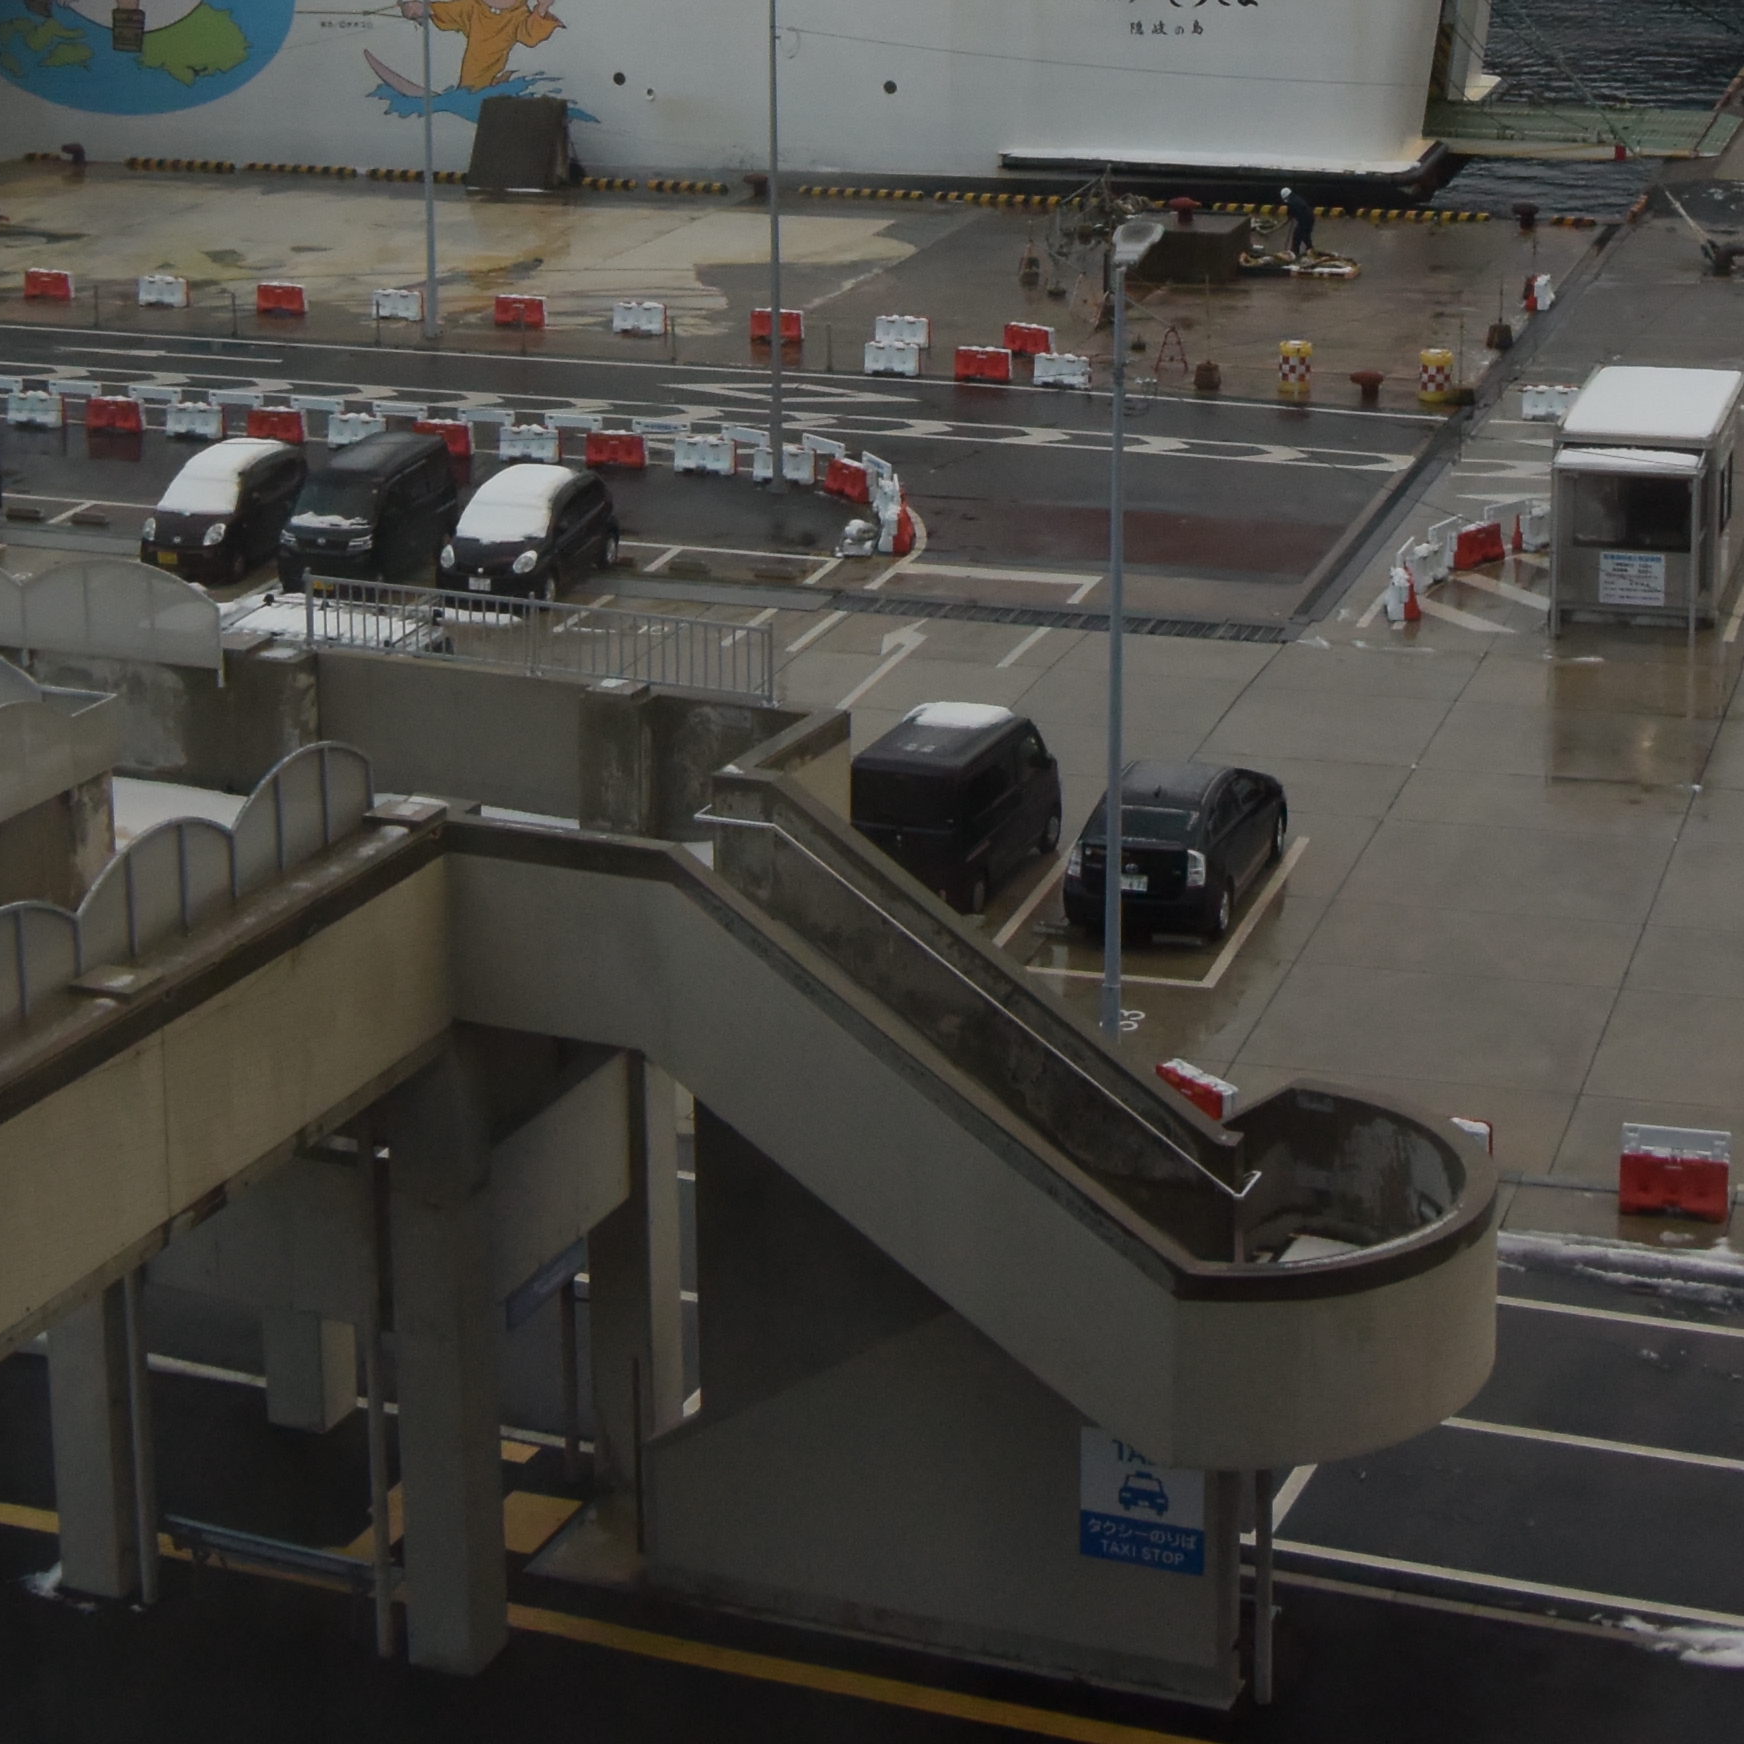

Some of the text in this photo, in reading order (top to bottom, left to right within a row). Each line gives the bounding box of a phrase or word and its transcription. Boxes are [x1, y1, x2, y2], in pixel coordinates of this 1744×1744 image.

[1112, 1439, 1156, 1466] TA
[1088, 1518, 1197, 1550] タクシーのりば
[1100, 1539, 1185, 1566] TAXI STOP
